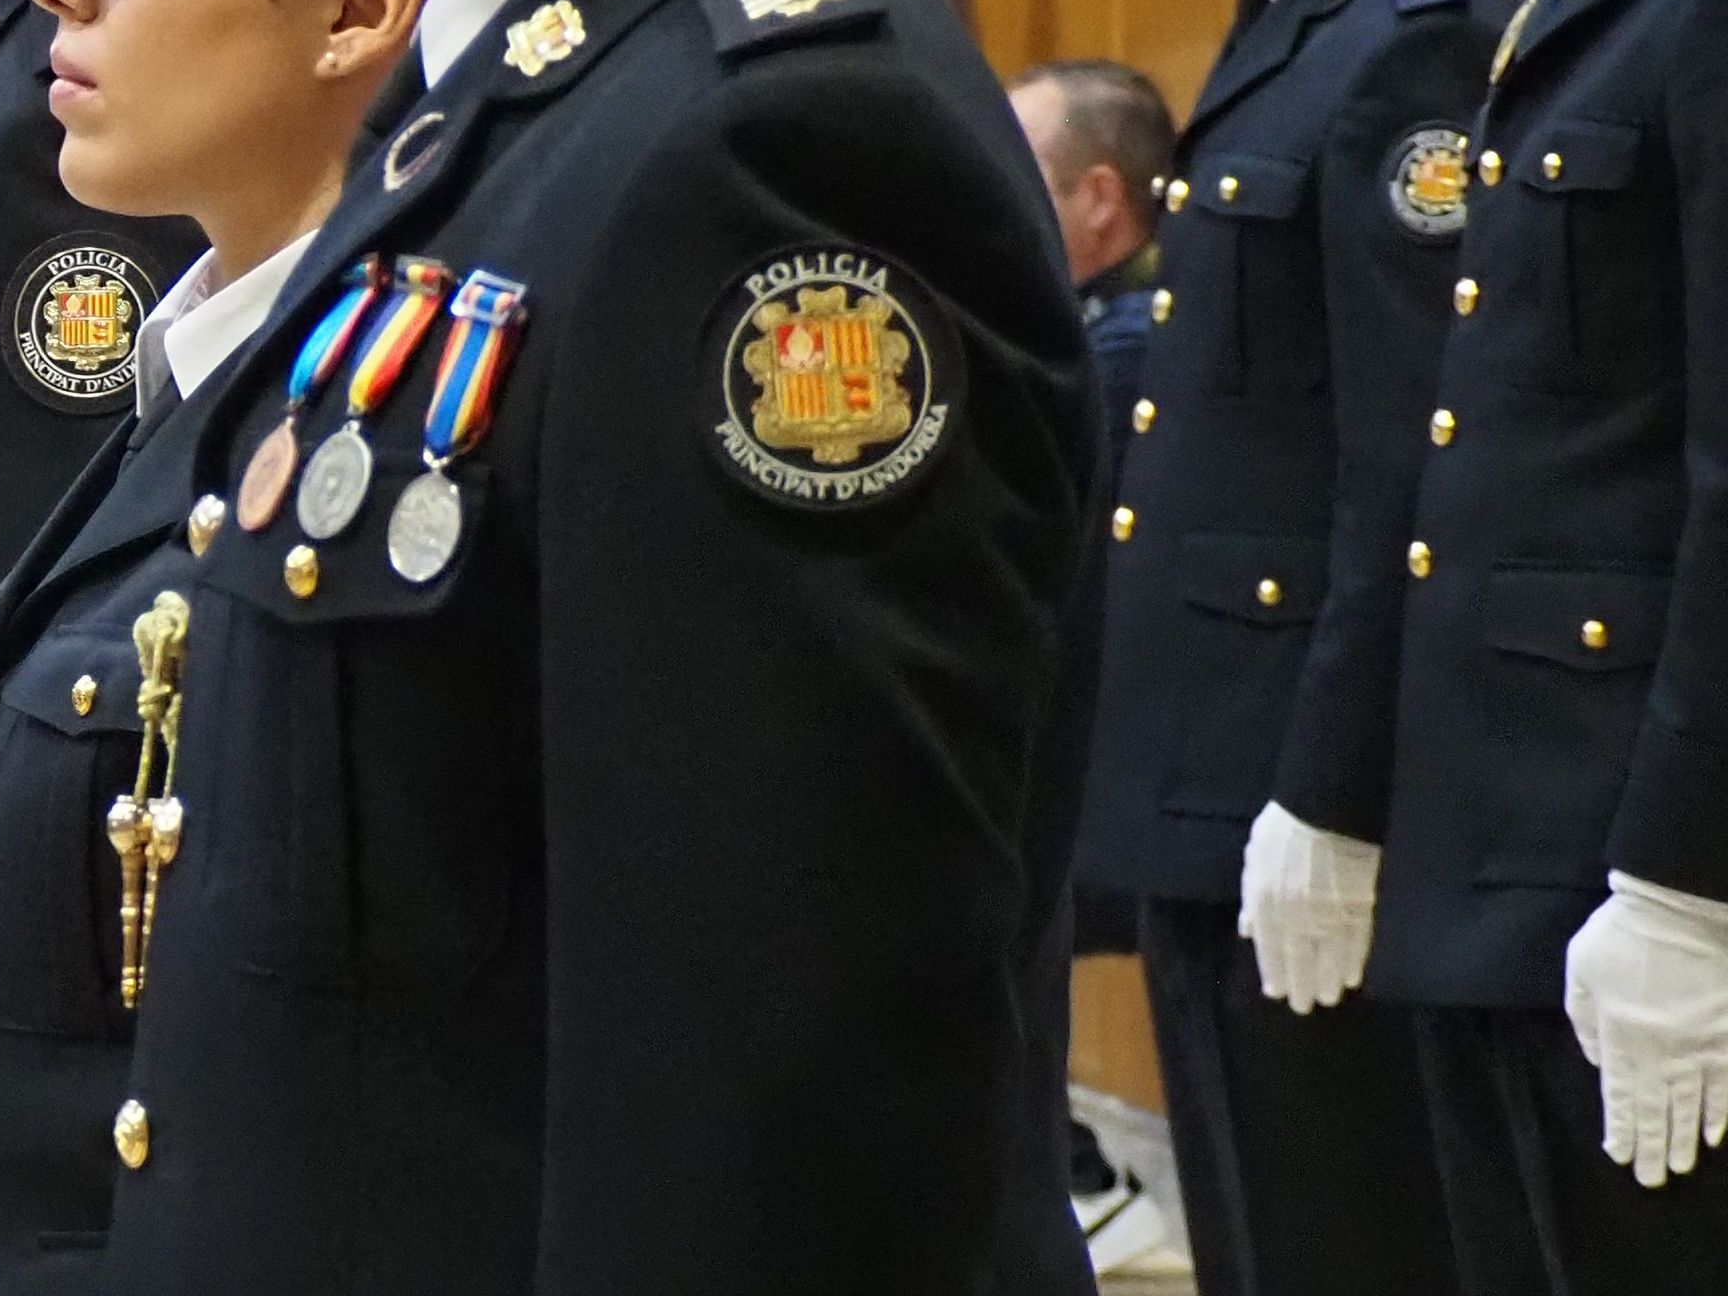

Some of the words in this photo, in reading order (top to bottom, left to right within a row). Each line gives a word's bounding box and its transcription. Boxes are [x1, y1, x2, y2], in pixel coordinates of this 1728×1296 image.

[47, 251, 127, 276] POLICIA
[745, 252, 888, 300] POLICIA
[19, 331, 81, 392] PRINCIPAT
[715, 420, 828, 500] PRINCIPAT
[835, 404, 949, 501] D'ANDORRA
